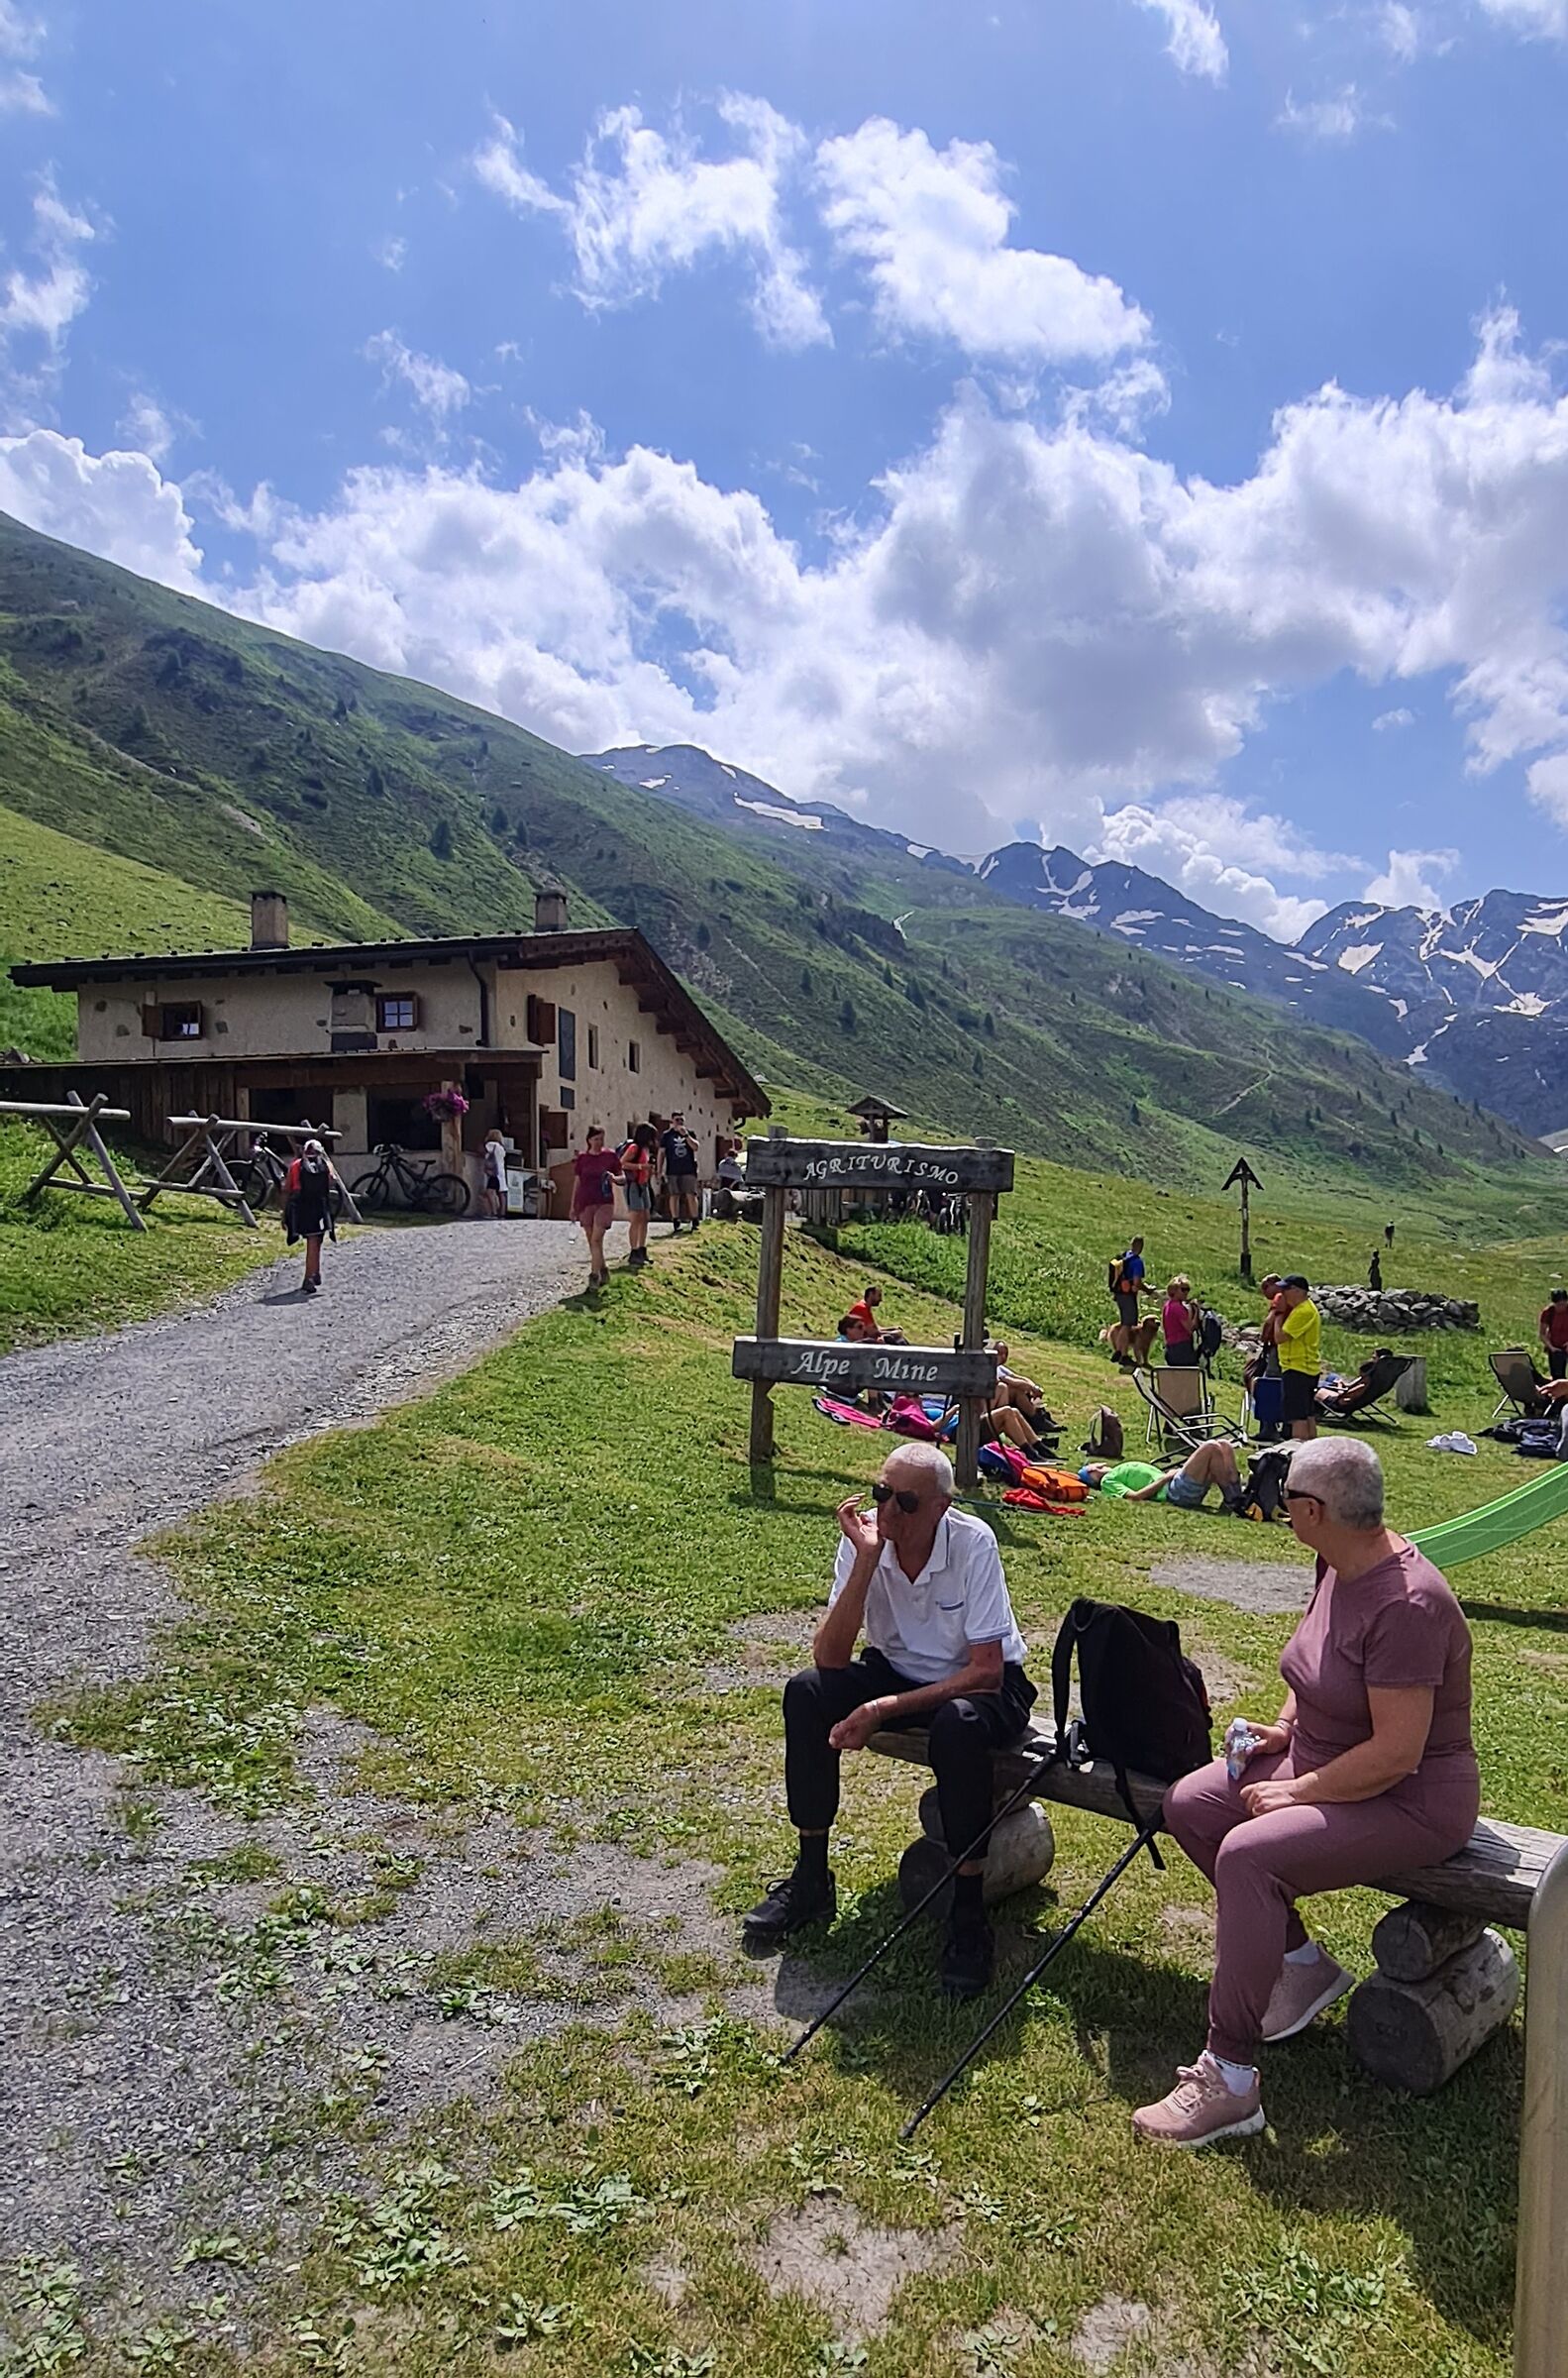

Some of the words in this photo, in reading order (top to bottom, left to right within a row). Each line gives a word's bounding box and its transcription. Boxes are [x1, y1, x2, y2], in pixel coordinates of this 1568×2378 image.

[803, 1154, 958, 1184] AGRITURISMO
[790, 1351, 850, 1381] Alpe
[874, 1357, 938, 1381] Mine
